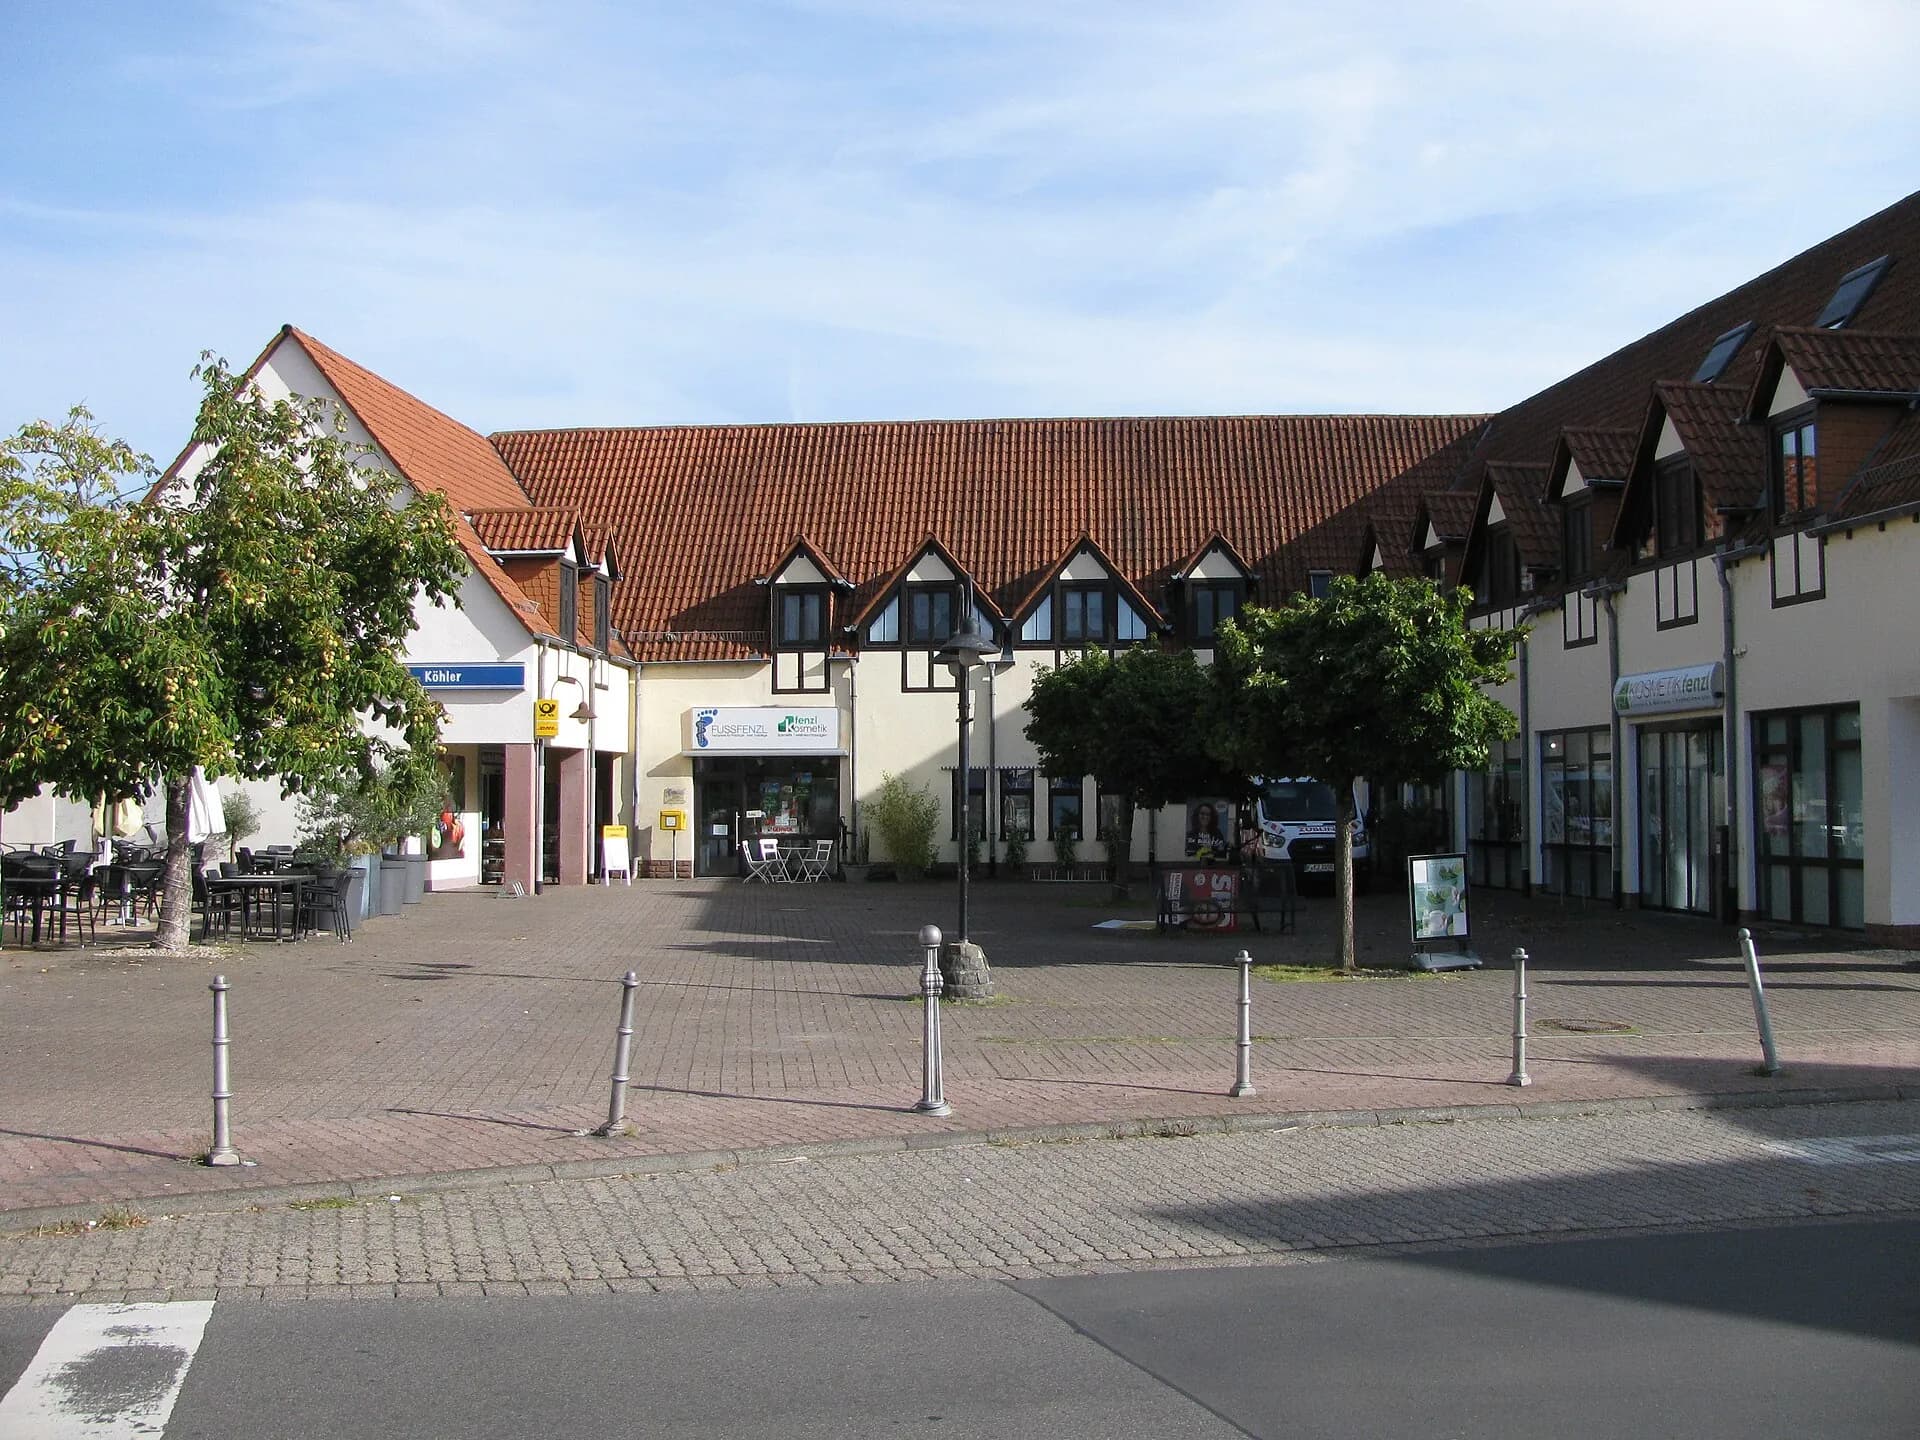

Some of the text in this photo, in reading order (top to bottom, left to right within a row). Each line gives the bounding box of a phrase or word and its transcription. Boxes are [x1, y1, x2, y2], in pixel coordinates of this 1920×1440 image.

[424, 669, 462, 683] Köhler
[1682, 672, 1711, 695] fenzl
[795, 715, 818, 725] fenzl
[711, 725, 768, 734] FUSSFENZL
